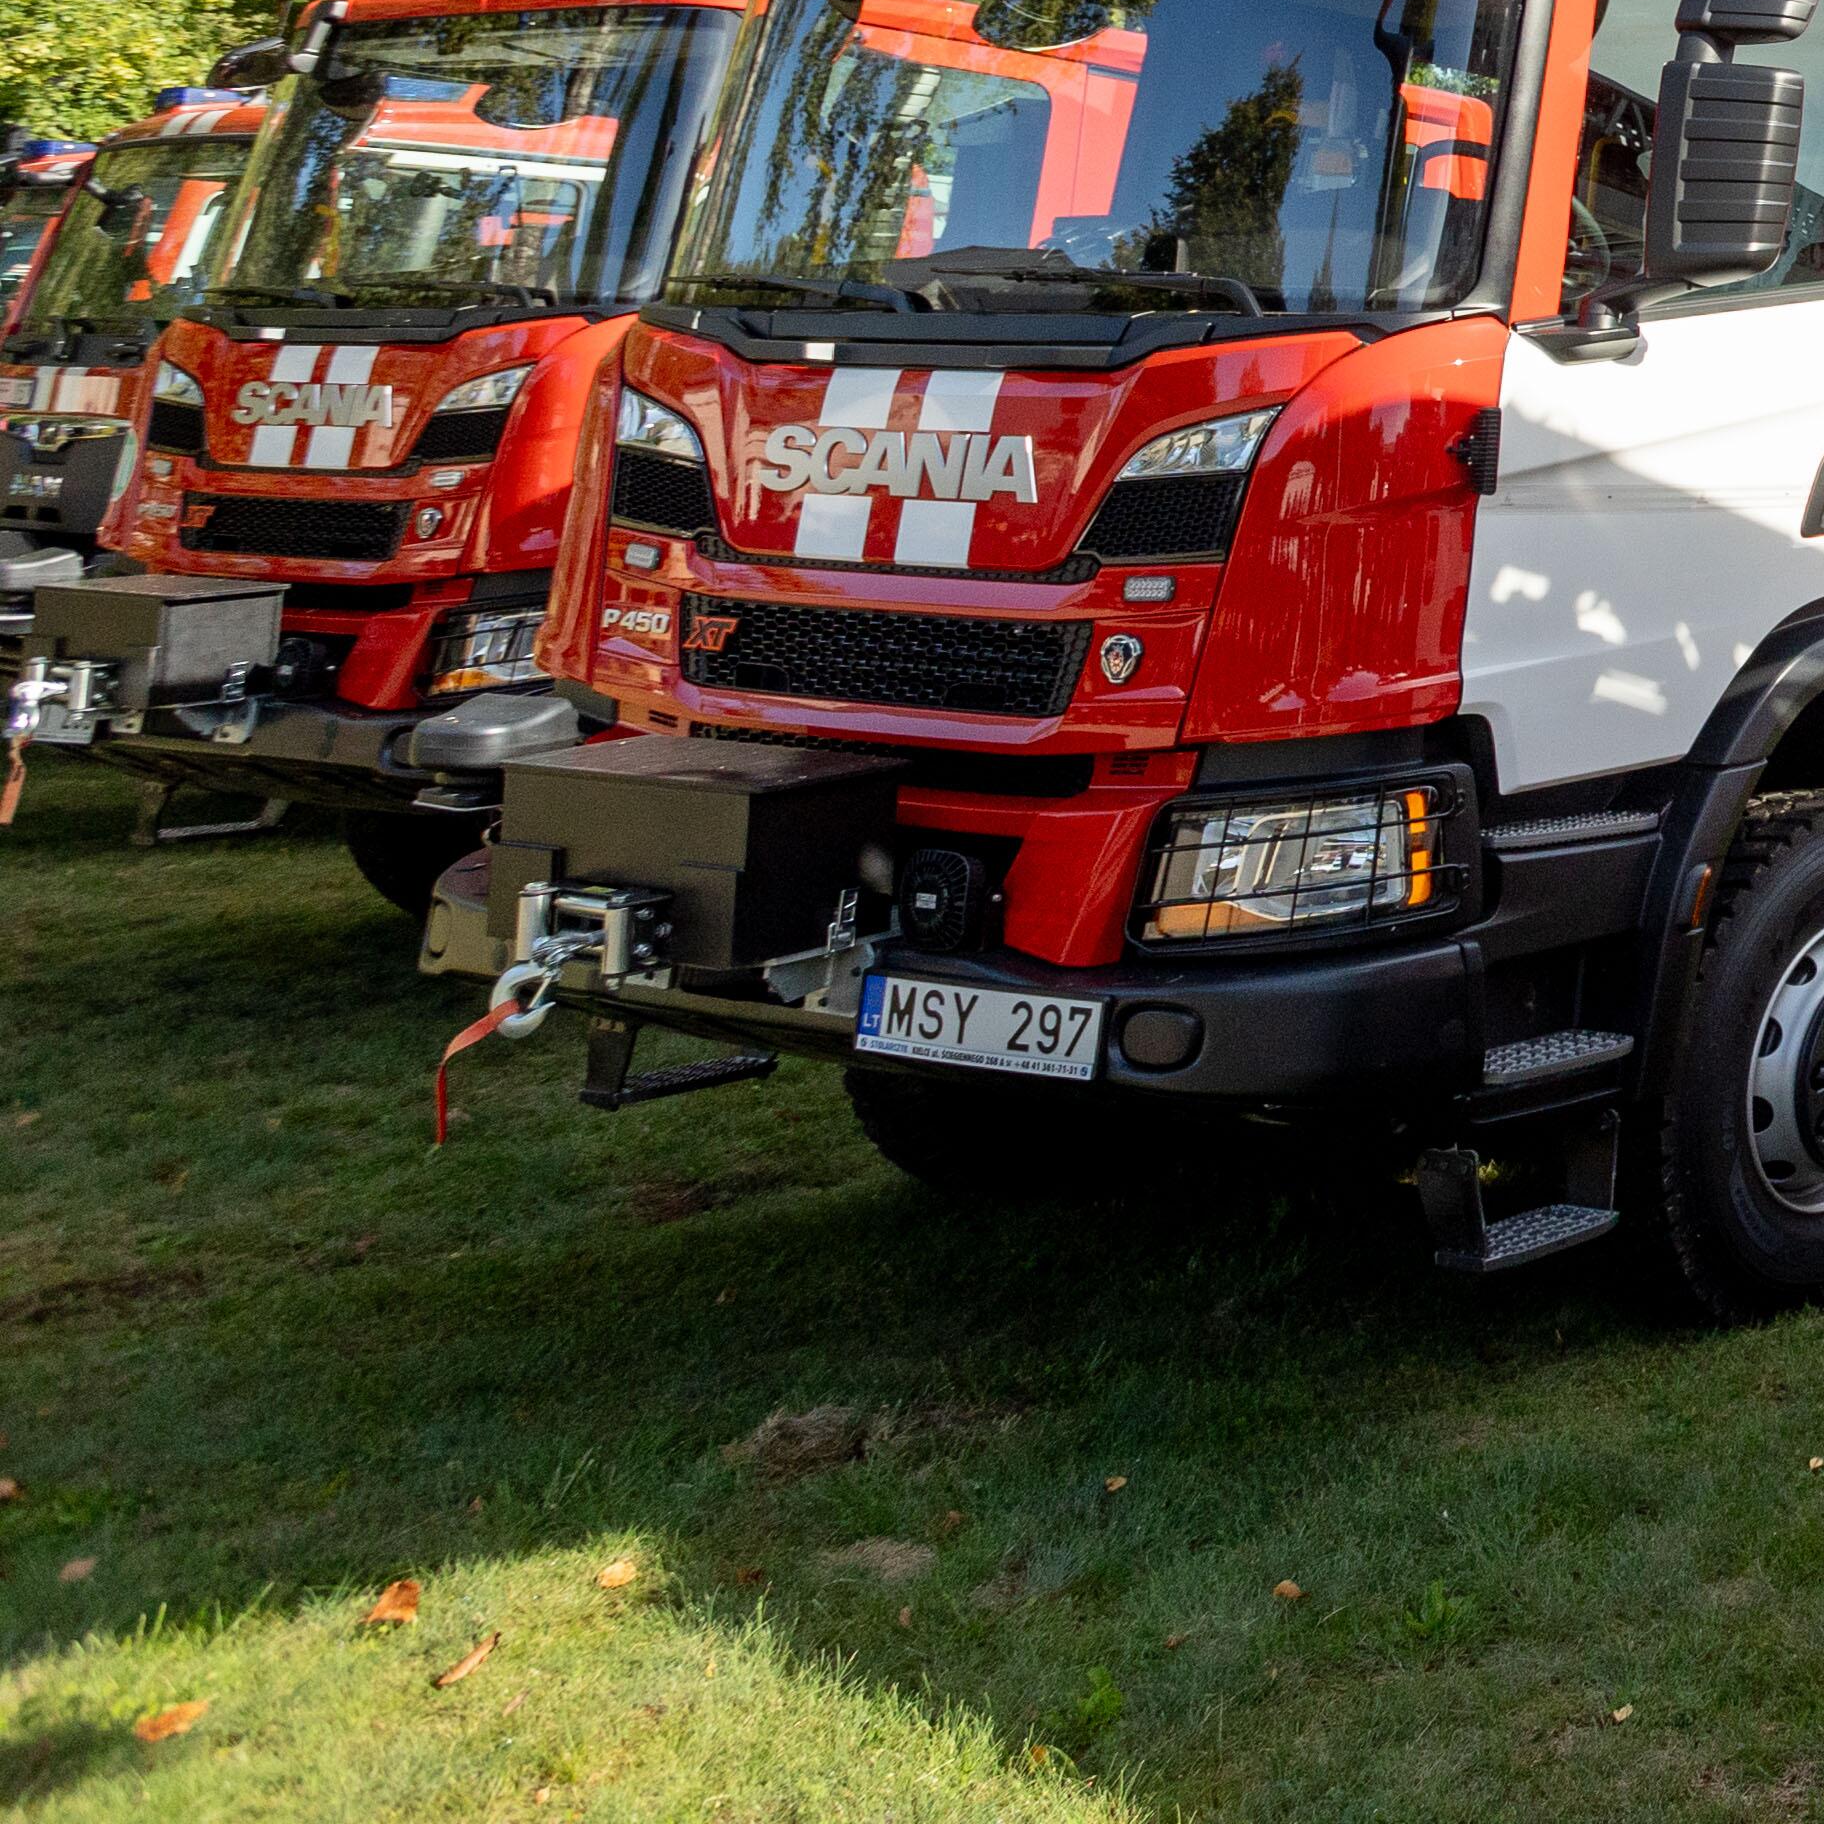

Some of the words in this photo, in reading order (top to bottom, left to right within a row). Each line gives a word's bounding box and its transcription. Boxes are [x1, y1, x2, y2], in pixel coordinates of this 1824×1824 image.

[230, 380, 393, 427] SCANIA
[760, 425, 1038, 504] SCANIA
[601, 608, 621, 628] P
[620, 610, 670, 634] 450
[682, 615, 738, 651] XT
[863, 1012, 880, 1027] LT
[886, 984, 980, 1044] MSY
[1006, 1000, 1094, 1057] 297
